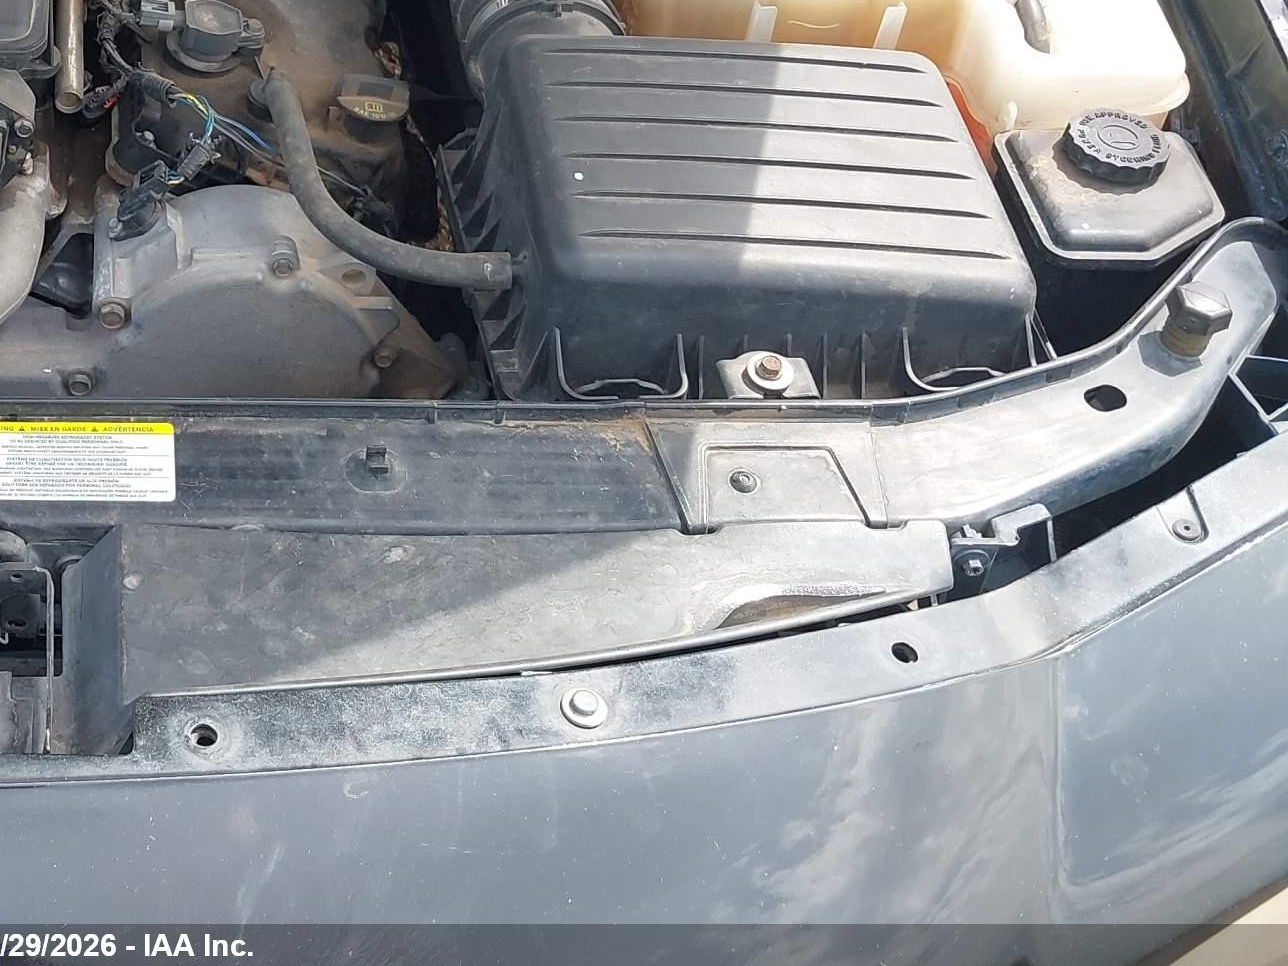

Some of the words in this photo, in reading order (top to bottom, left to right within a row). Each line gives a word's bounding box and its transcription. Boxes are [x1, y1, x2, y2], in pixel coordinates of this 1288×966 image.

[1094, 111, 1148, 129] APPROVED
[1105, 152, 1155, 164] STEERING
[102, 425, 154, 433] ADVERTENCIA
